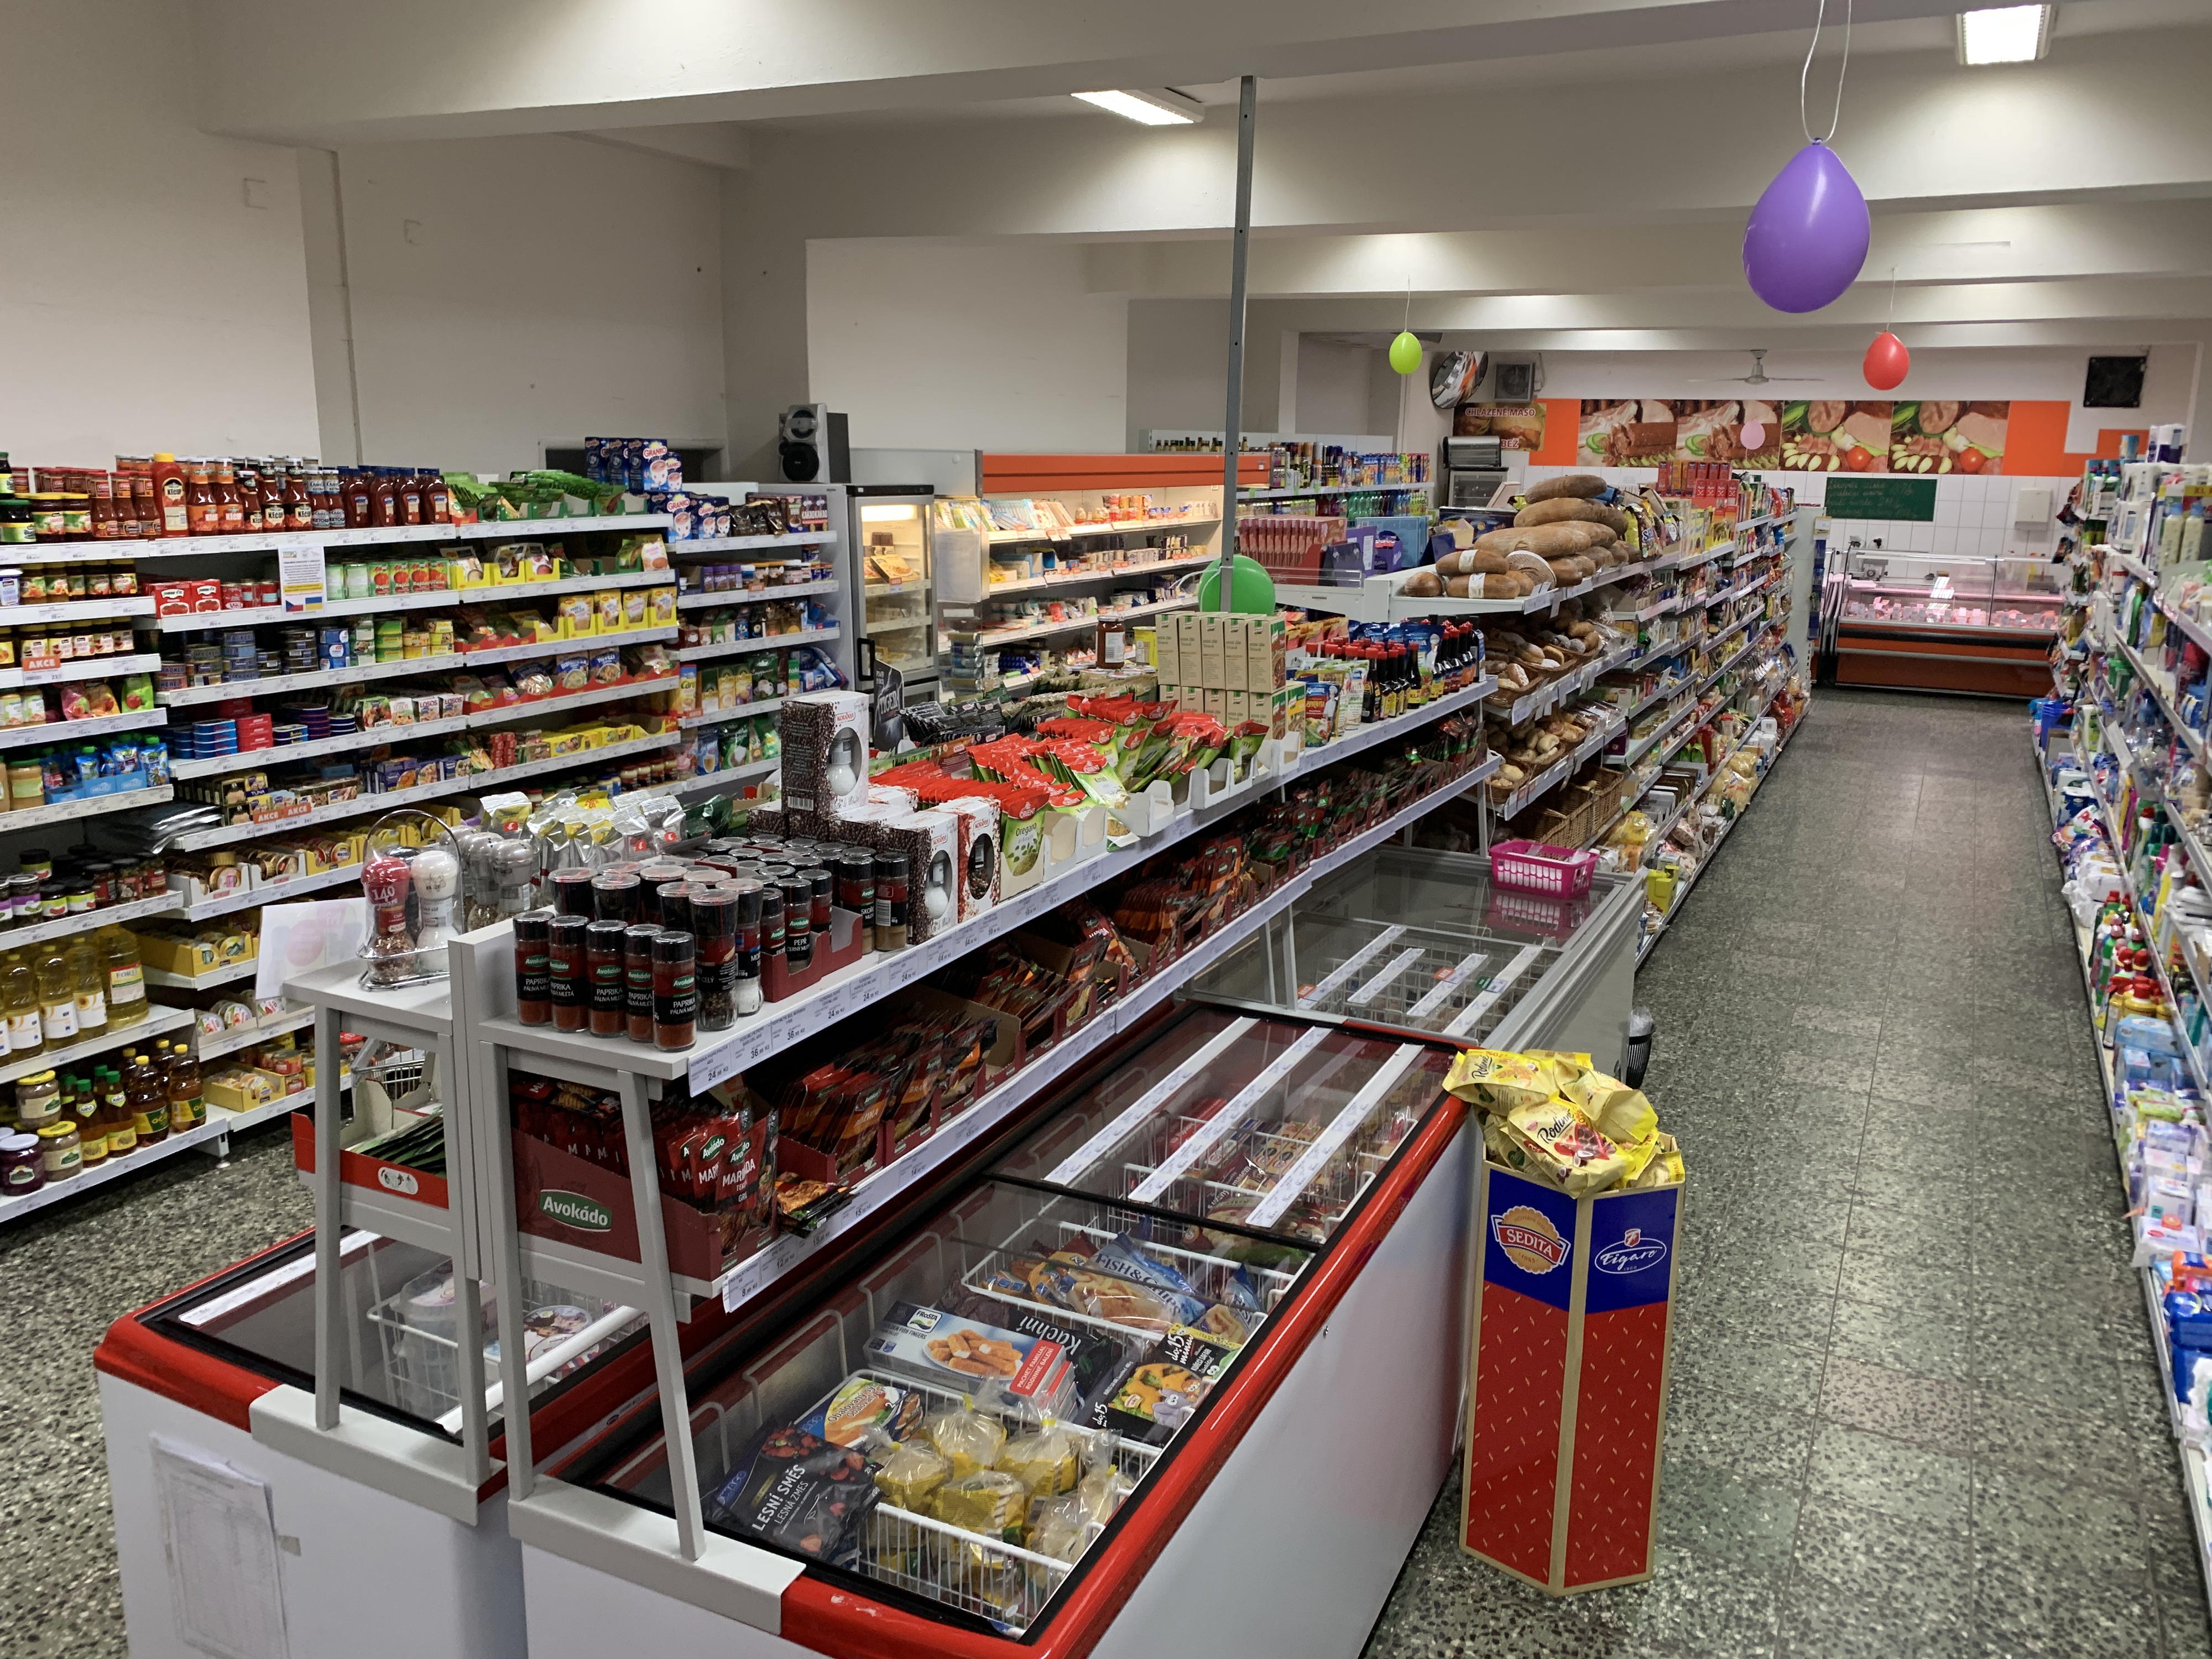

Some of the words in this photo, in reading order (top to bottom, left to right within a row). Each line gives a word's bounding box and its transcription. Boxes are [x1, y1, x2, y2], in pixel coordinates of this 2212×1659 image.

[1466, 406, 1507, 416] CHLAZENÉ
[1510, 408, 1536, 417] MASO
[1501, 437, 1519, 448] BEŽ
[644, 447, 667, 457] GRANKO
[667, 500, 690, 510] GRANKO
[28, 658, 55, 669] AKCE
[258, 812, 278, 822] AKCE
[288, 805, 307, 816] AKCE
[1020, 807, 1036, 818] ORIENT
[1015, 822, 1037, 837] Oregano
[372, 886, 395, 902] 140
[794, 937, 807, 946] PEPŘ
[596, 967, 622, 975] Avokádo
[628, 972, 652, 980] Avokádo
[543, 1196, 608, 1227] Avokádo
[1506, 1228, 1553, 1258] SEDITA
[1600, 1246, 1663, 1271] Figaro
[910, 1329, 927, 1340] FINGERS
[1015, 1315, 1082, 1356] Kachní
[1167, 1332, 1185, 1348] 15
[1017, 1370, 1030, 1389] PACHET
[1029, 1345, 1046, 1368] FAMILIAL
[827, 1392, 867, 1423] Obalovaný
[1094, 1402, 1108, 1417] 15
[752, 1493, 781, 1532] LESNÍ
[776, 1464, 806, 1495] SMĚS
[774, 1497, 796, 1525] LESNÁ
[790, 1480, 809, 1500] ZMES
